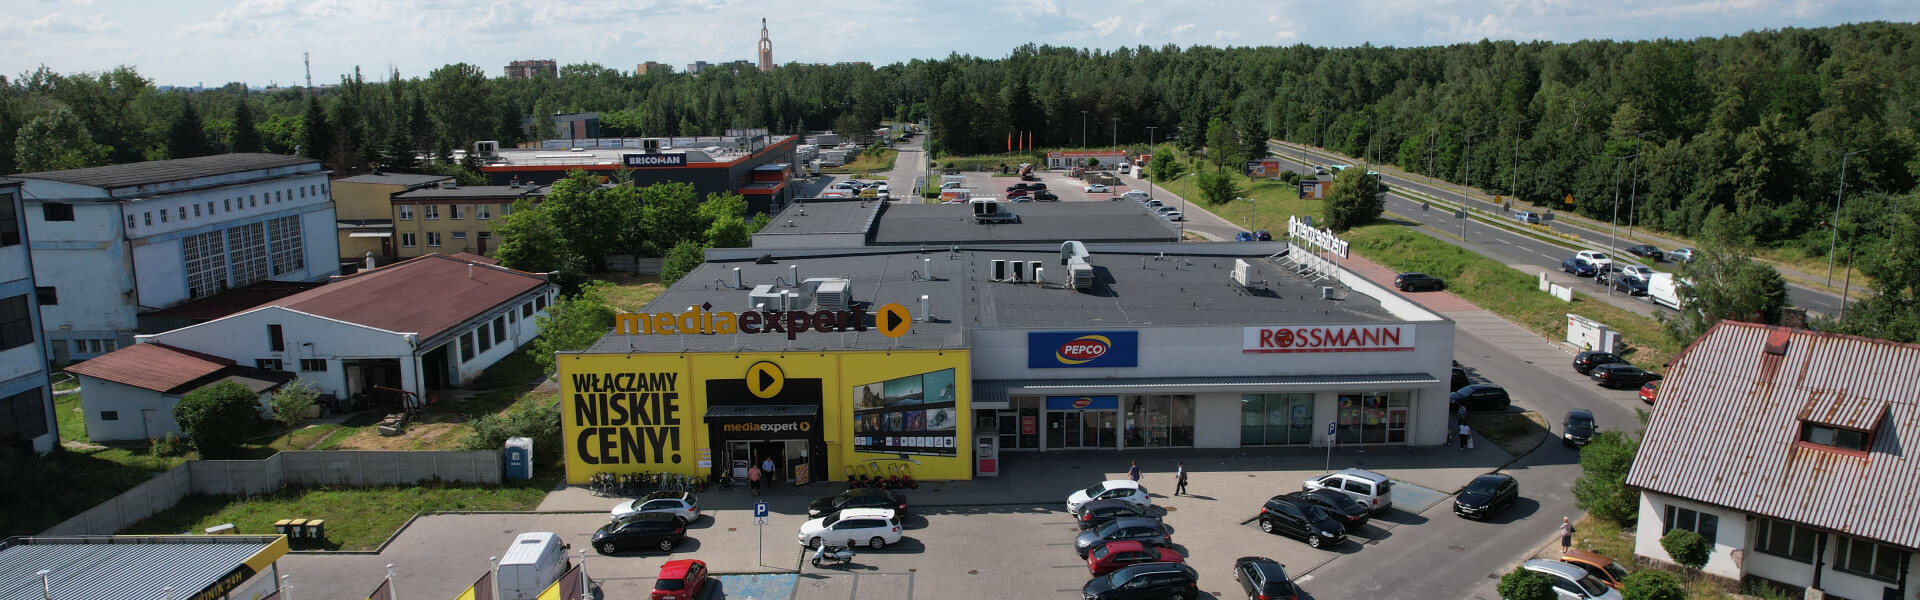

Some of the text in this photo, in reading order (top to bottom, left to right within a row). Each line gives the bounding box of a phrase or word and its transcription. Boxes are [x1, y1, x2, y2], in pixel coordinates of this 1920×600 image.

[615, 302, 868, 340] mediaexpert
[1259, 326, 1401, 349] ROSSMANN
[1064, 344, 1103, 355] PEPCO
[572, 372, 678, 395] WŁĄCZAMY
[574, 392, 680, 426] NISKIE
[723, 420, 798, 434] mediaexpert
[577, 426, 682, 465] CENY!
[757, 504, 766, 516] P
[225, 571, 242, 589] 24H
